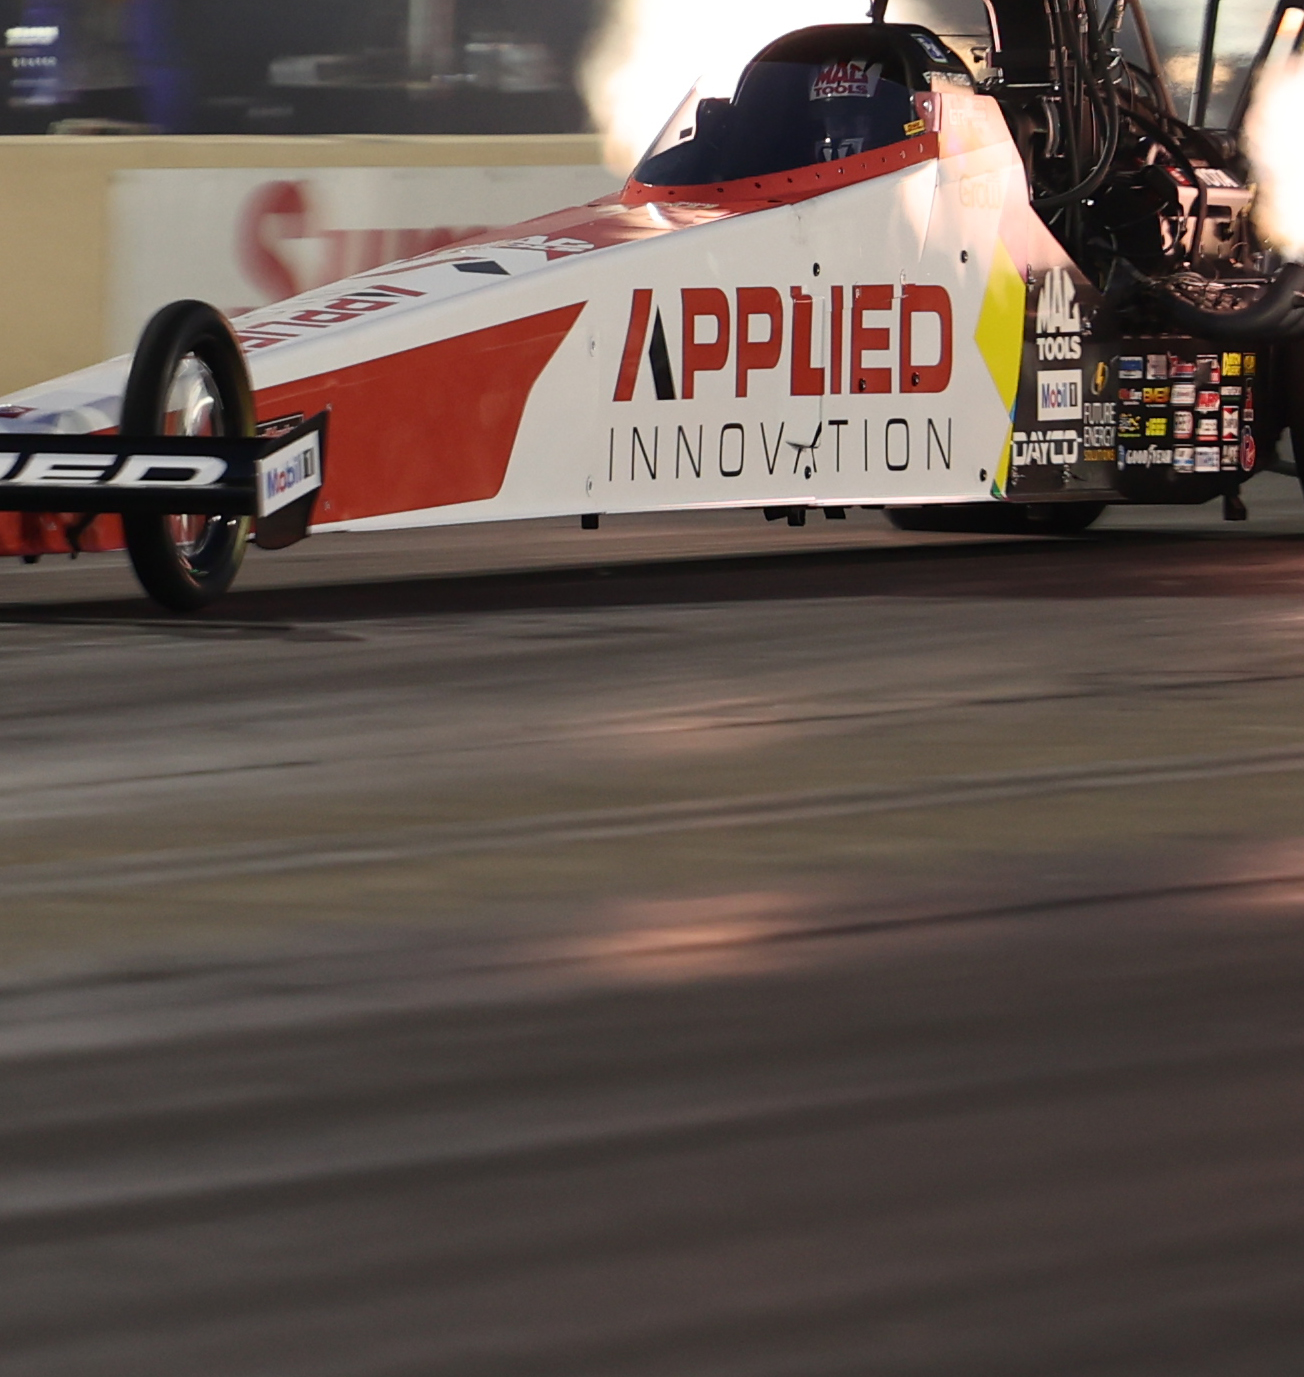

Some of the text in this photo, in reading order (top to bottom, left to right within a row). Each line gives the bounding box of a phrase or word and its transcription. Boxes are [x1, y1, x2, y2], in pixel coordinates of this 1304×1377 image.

[814, 61, 868, 87] MAC
[814, 84, 868, 98] TOOLS
[1036, 266, 1081, 334] MAC
[612, 284, 953, 402] APPLIED
[1036, 336, 1082, 361] TOOLS
[1041, 382, 1068, 409] Mobil
[609, 417, 952, 482] INNOVATION
[1012, 430, 1079, 466] DAYCO
[266, 453, 303, 499] Mobil
